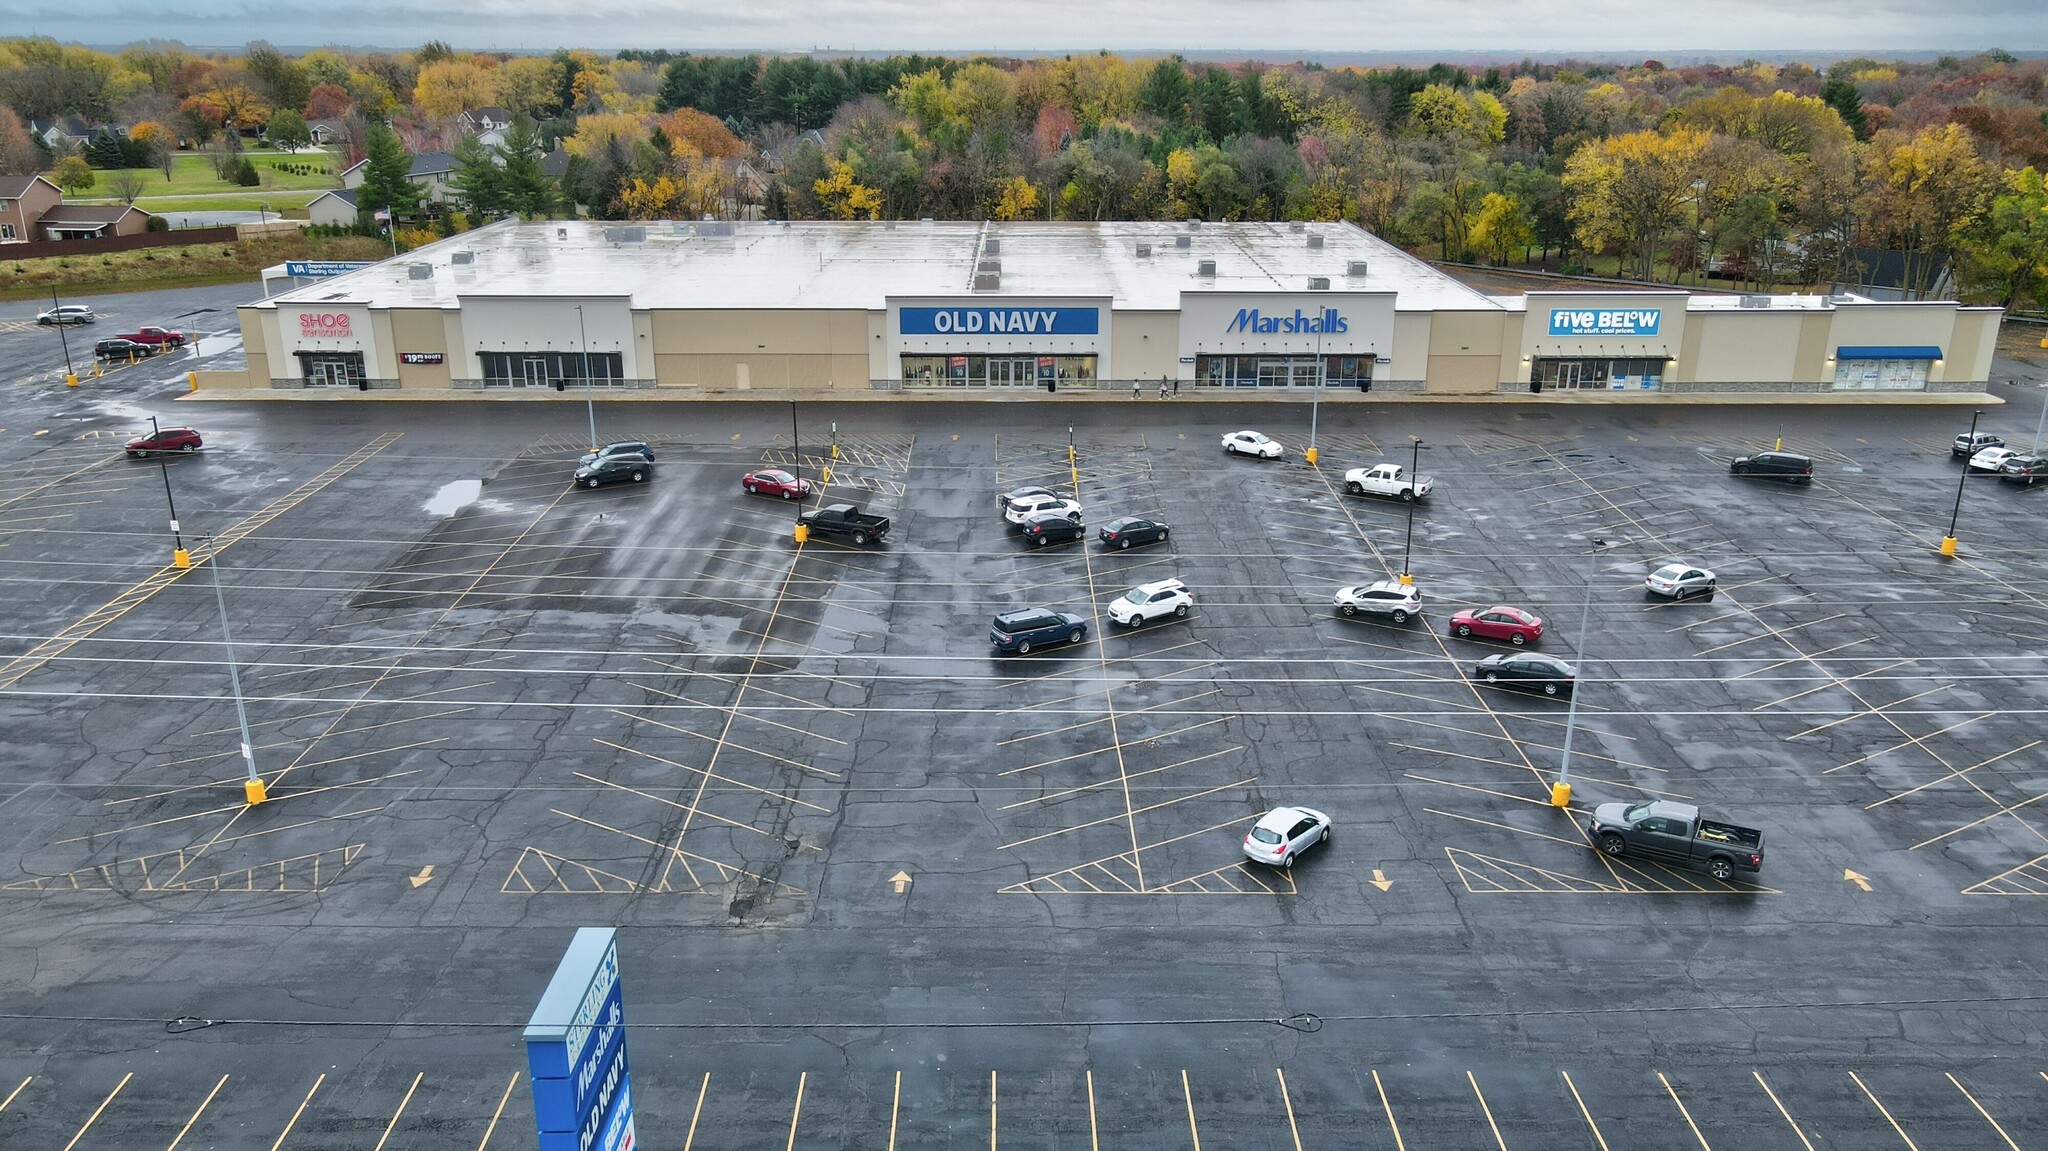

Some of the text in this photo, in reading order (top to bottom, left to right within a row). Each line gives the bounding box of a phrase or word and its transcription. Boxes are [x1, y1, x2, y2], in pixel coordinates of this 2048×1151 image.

[292, 264, 305, 273] VA
[934, 311, 1057, 332] OLD NAVY
[1226, 308, 1348, 334] Marshalls
[1554, 311, 1659, 328] five BELOW
[301, 328, 353, 337] sensation
[1614, 327, 1636, 335] prices.
[576, 1000, 621, 1113] Marshalls
[580, 1104, 600, 1151] OLD
[599, 1042, 624, 1115] NAVY
